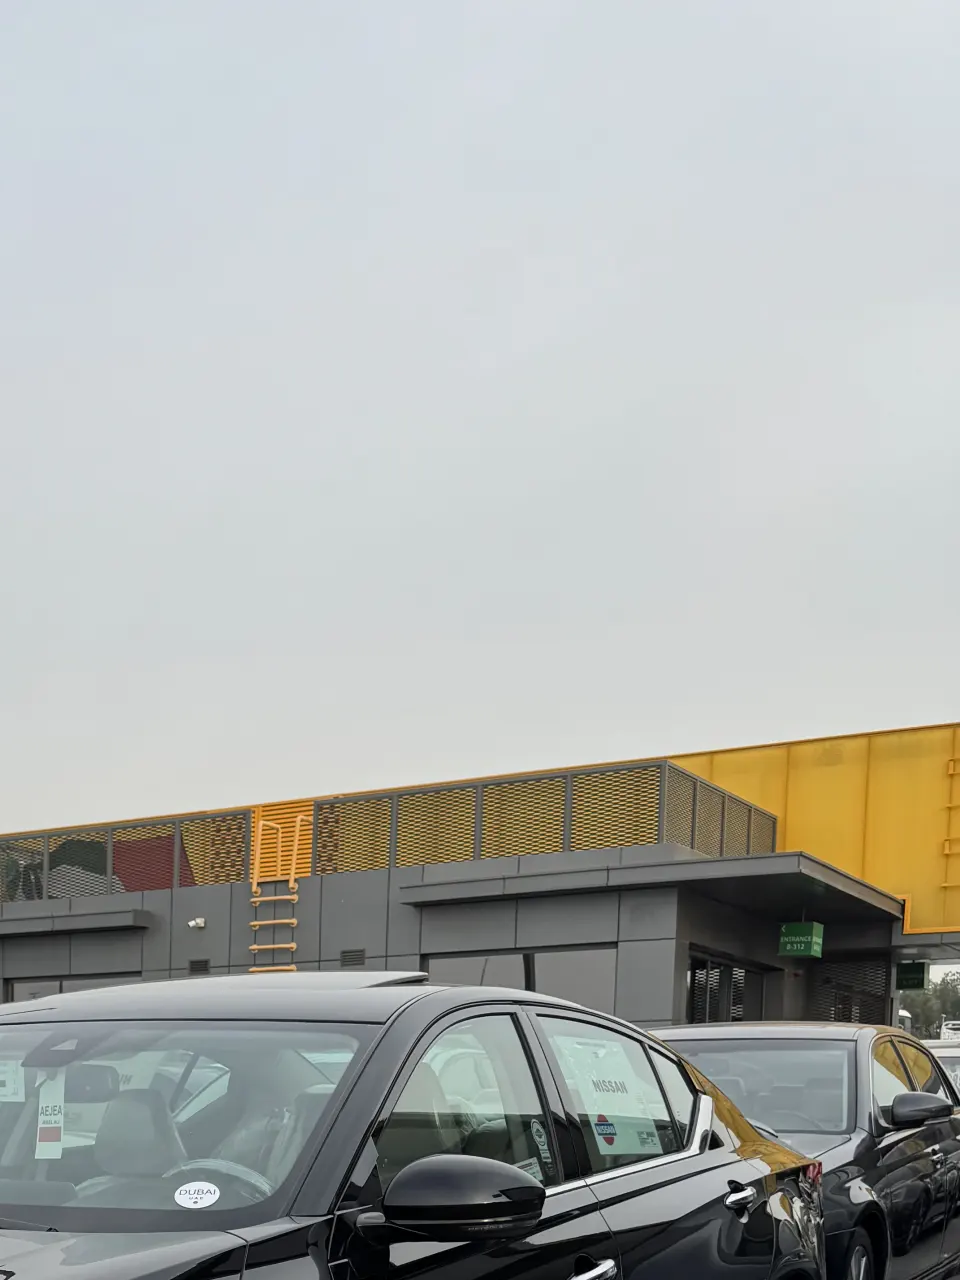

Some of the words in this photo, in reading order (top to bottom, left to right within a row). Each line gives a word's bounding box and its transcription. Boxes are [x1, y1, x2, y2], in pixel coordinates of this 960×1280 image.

[780, 935, 812, 943] ENTRANCE
[592, 1079, 629, 1094] NISSAN
[40, 1104, 63, 1117] AEJEA
[595, 1125, 616, 1134] NISSAN
[179, 1188, 216, 1196] DUBAI
